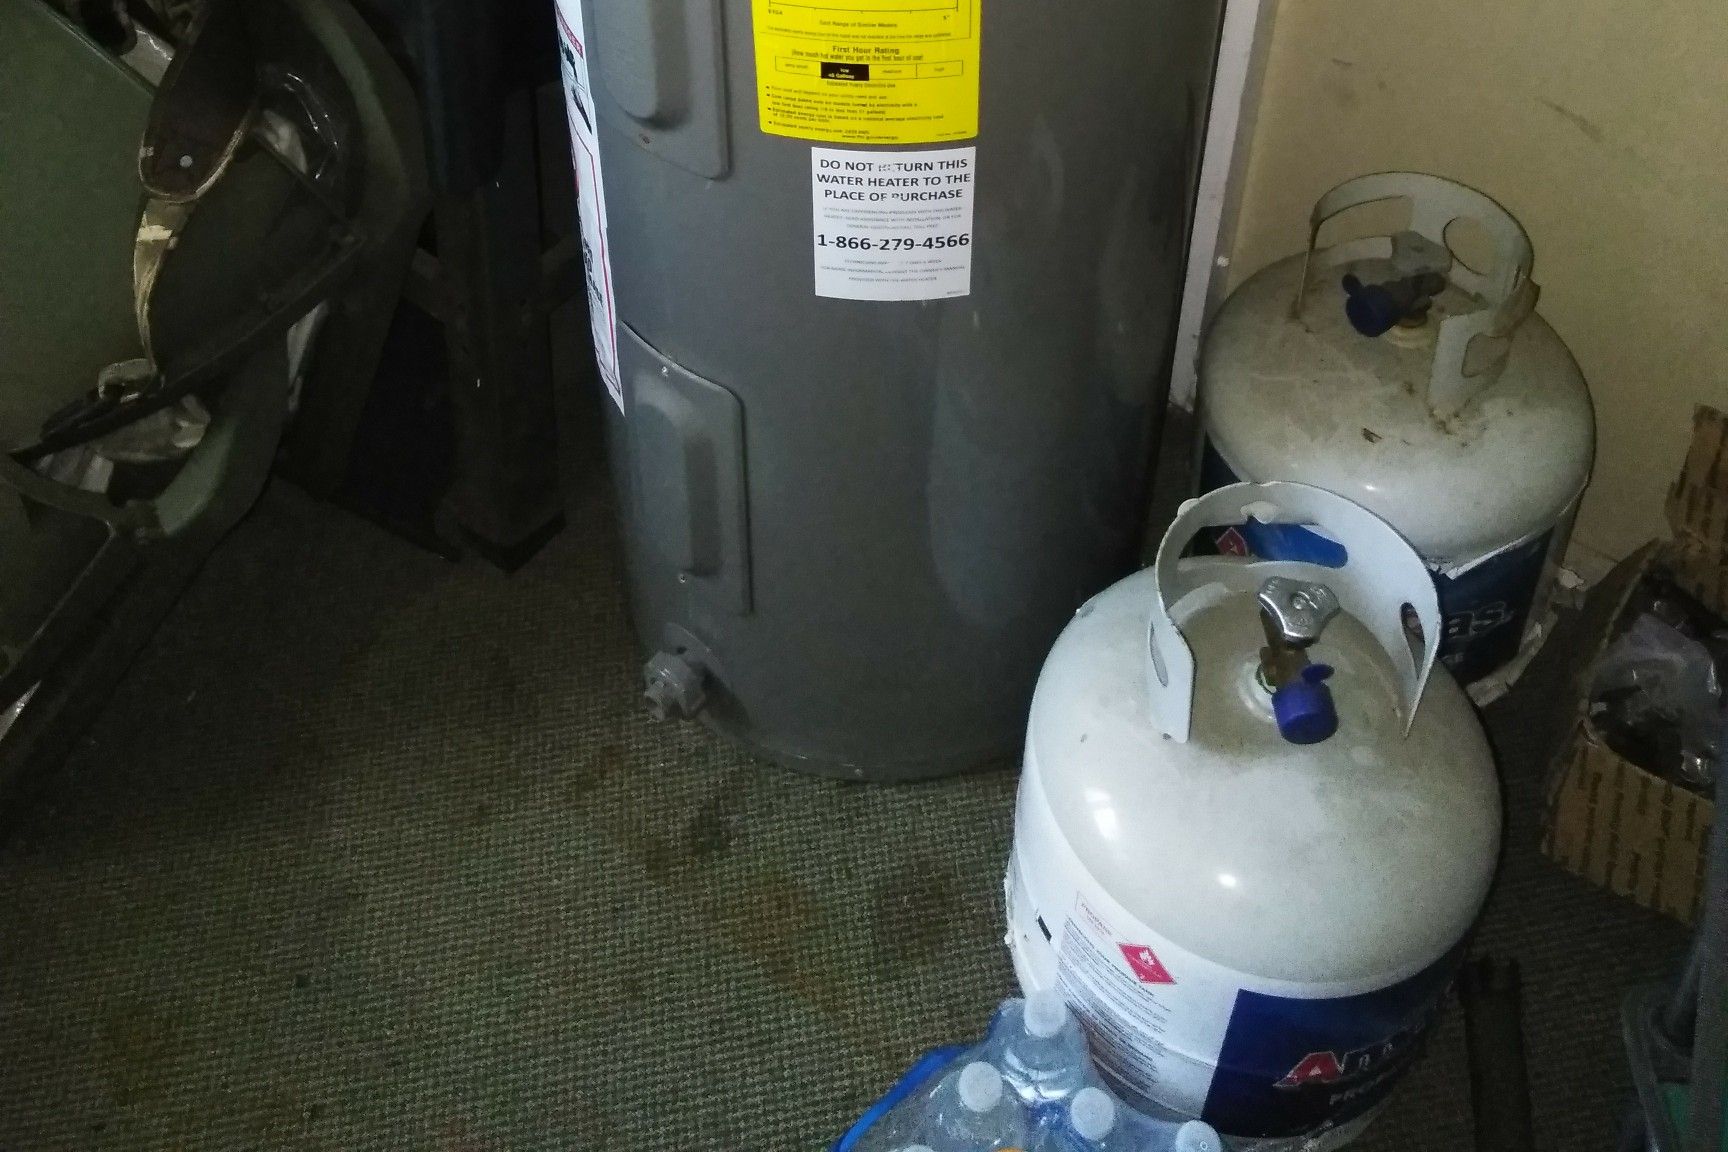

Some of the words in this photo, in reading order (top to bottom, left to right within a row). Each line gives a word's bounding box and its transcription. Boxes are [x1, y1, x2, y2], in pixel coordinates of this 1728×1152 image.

[833, 45, 850, 53] First
[853, 46, 871, 54] Hour
[874, 47, 900, 55] Rating
[820, 159, 841, 170] DO
[845, 161, 874, 171] NOT
[937, 159, 968, 170] THIS
[817, 174, 864, 186] WATER
[868, 177, 919, 187] HEATER
[923, 176, 941, 186] TO
[945, 173, 971, 184] THE
[824, 189, 865, 201] PLACE
[869, 192, 888, 202] OF
[817, 233, 970, 251] 1-866-279-4566
